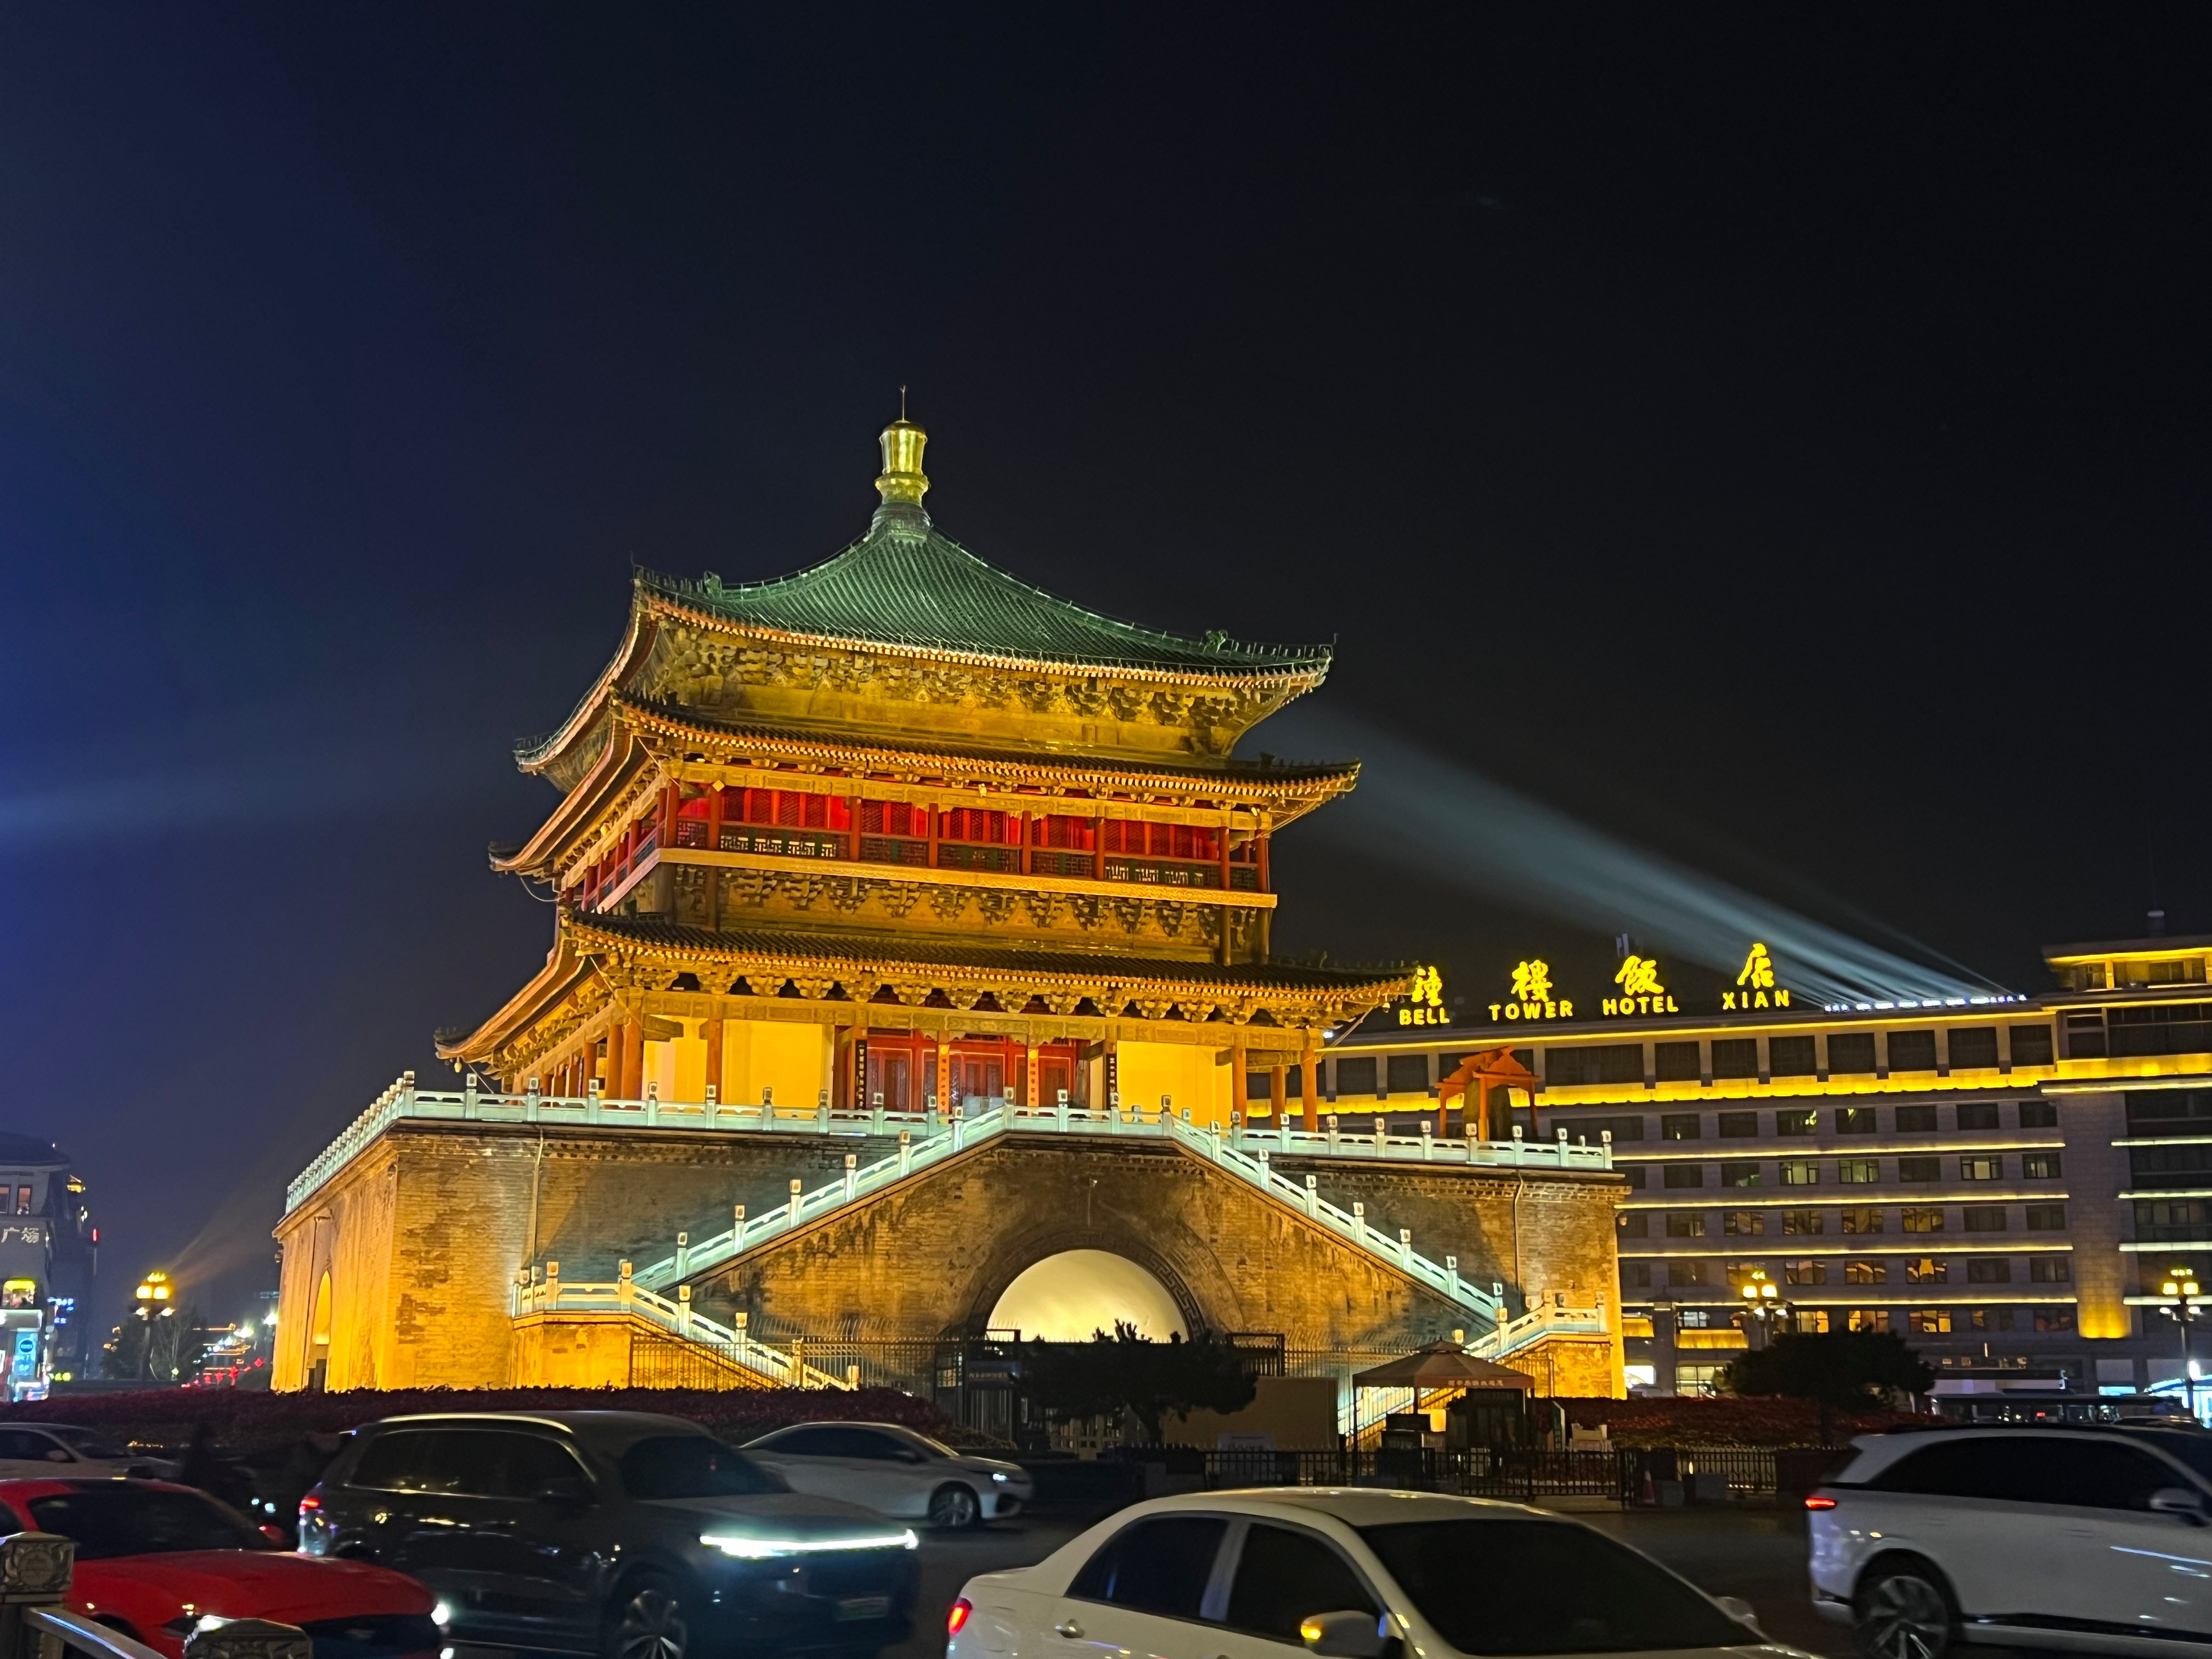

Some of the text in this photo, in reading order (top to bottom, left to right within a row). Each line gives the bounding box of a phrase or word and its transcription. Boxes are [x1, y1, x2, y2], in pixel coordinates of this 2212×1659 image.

[1400, 990, 1790, 1025] BELL TOWER HOTEL XIAN
[1, 1227, 40, 1243] 广场
